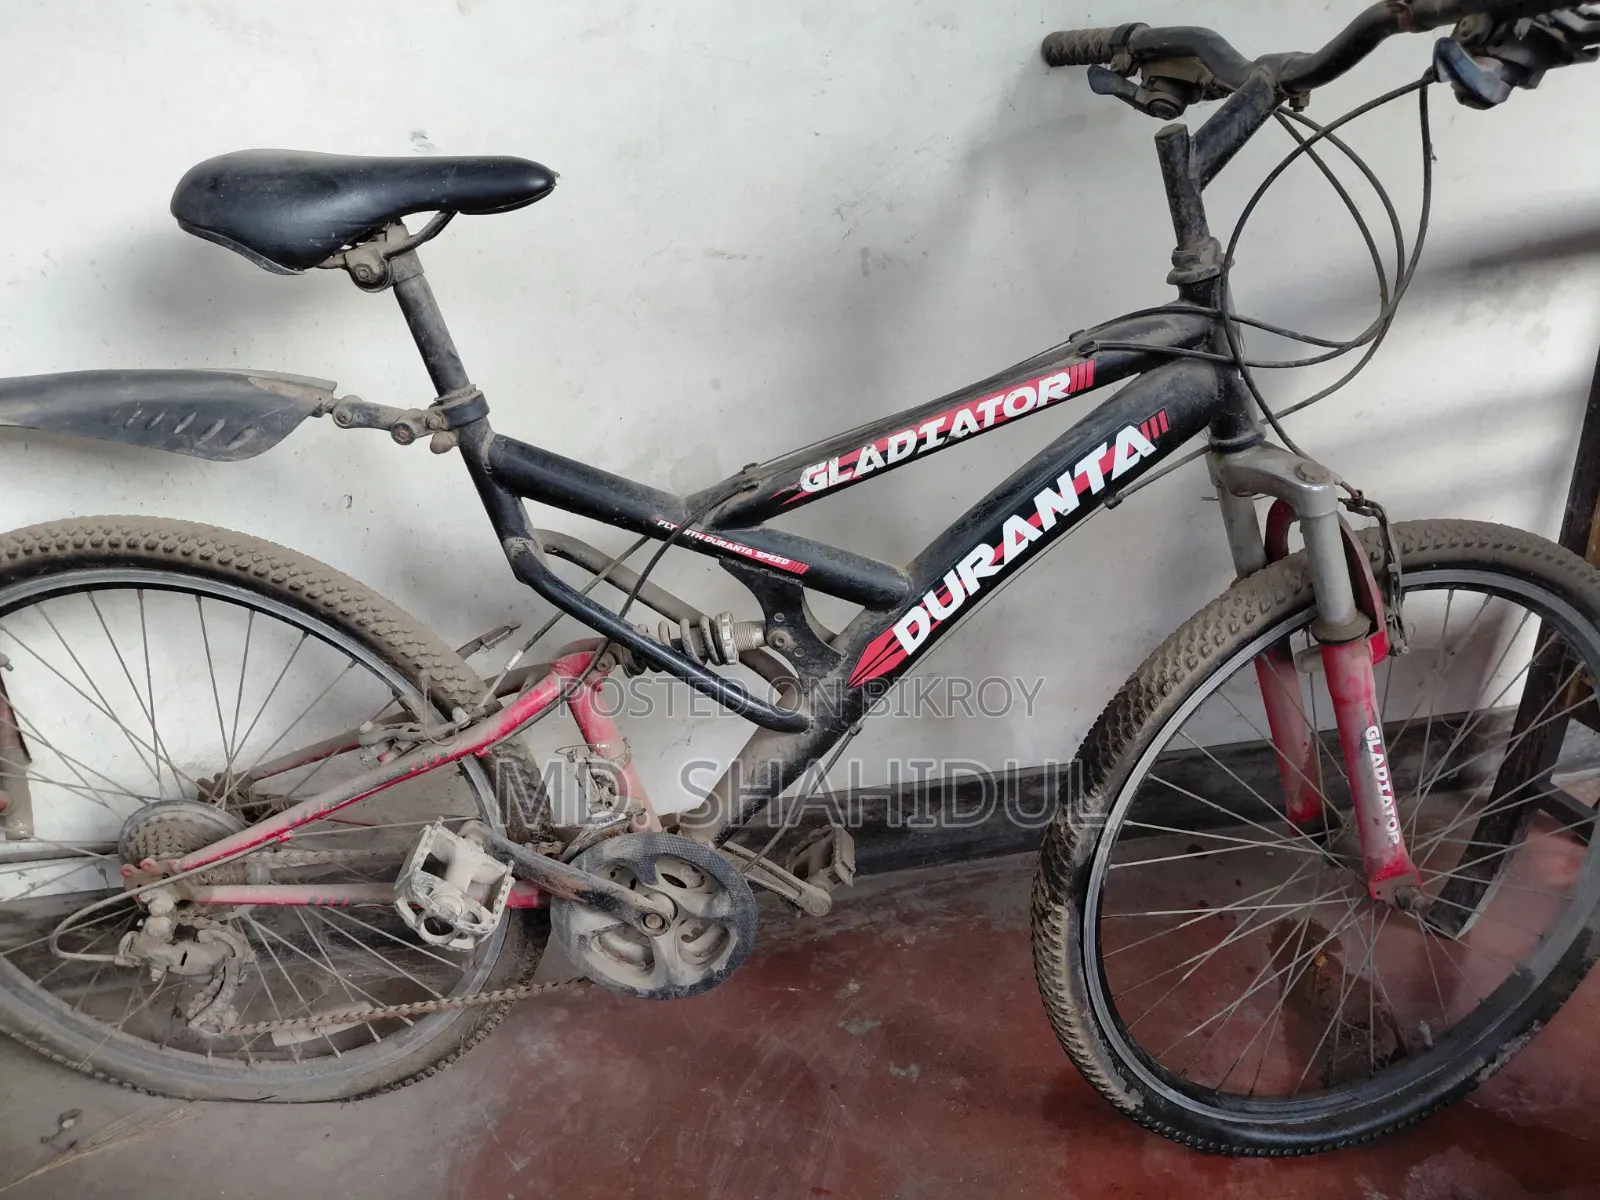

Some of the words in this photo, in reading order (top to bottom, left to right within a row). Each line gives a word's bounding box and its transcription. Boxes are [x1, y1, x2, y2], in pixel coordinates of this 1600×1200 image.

[800, 371, 1071, 493] GLADIATOR
[657, 520, 678, 531] FLY
[704, 535, 753, 555] DURANTA
[754, 551, 790, 565] SPEED
[892, 425, 1157, 655] DURANTA
